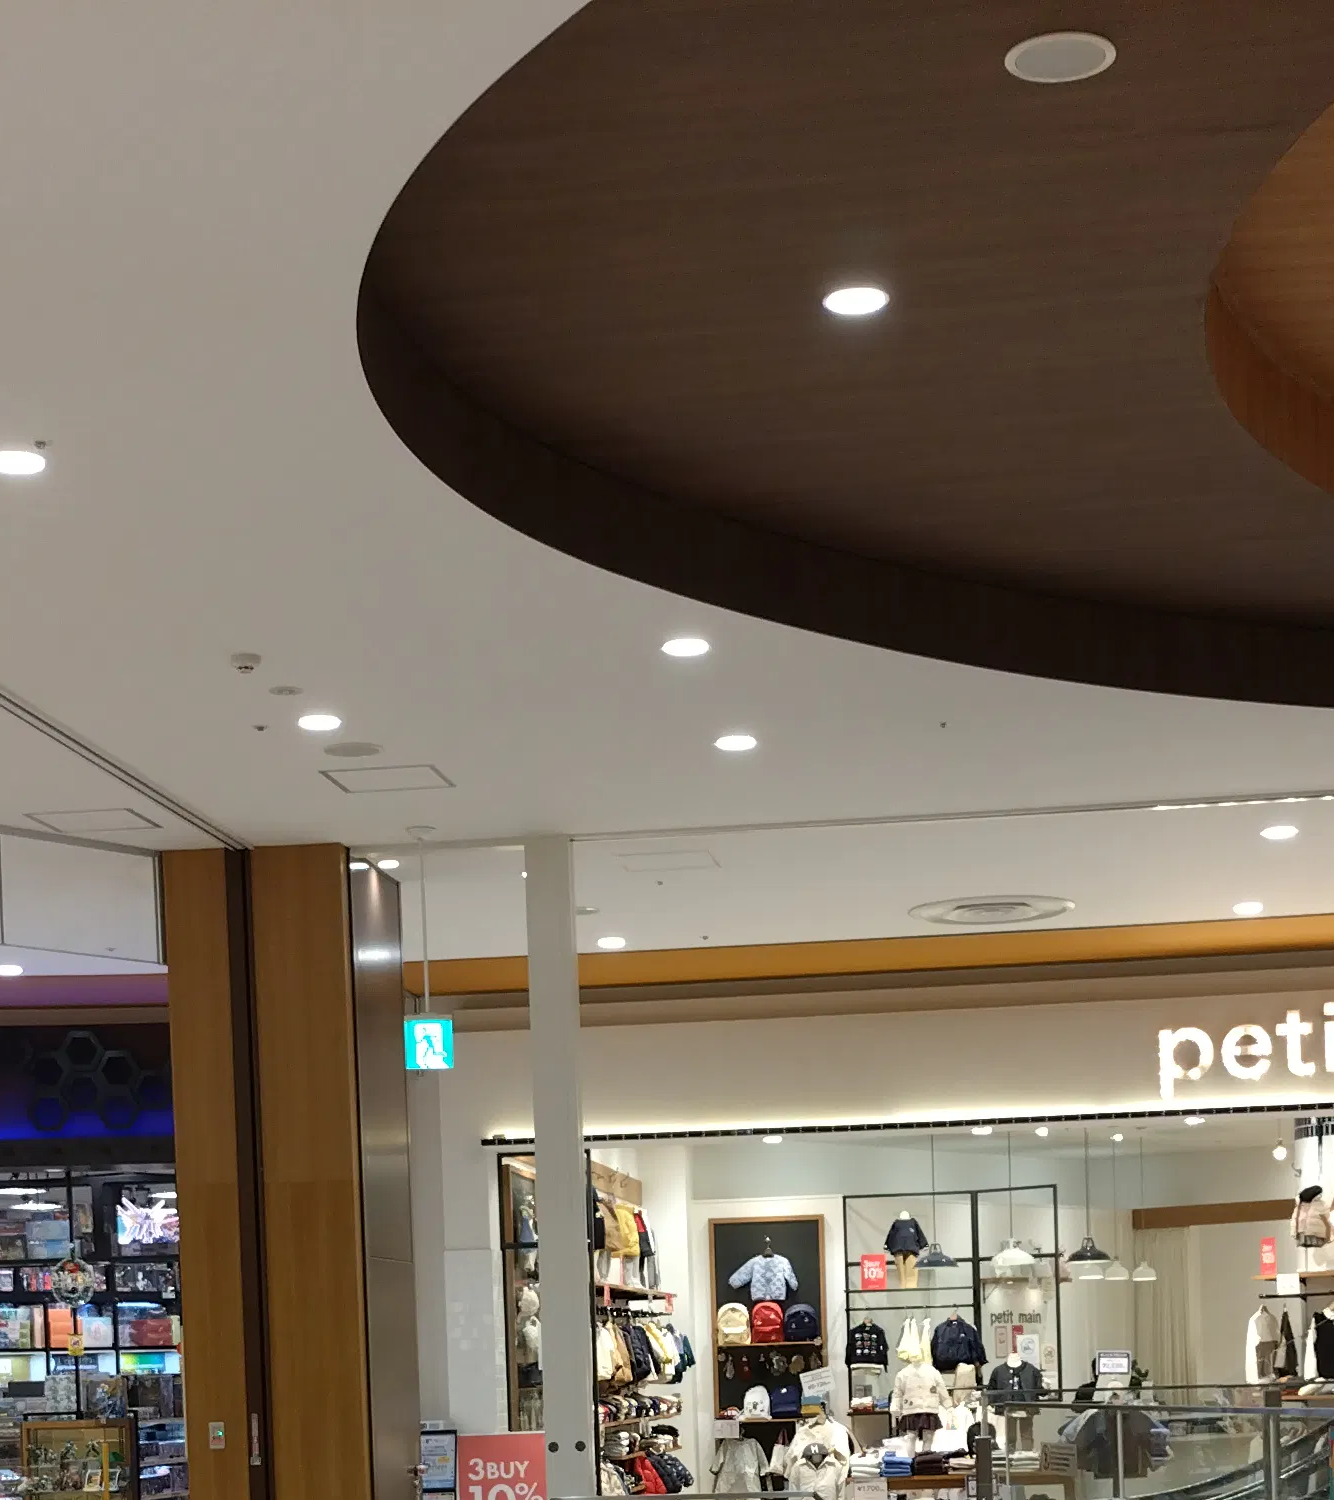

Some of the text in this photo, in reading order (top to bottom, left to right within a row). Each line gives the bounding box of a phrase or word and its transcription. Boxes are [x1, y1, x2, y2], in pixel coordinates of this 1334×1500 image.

[864, 1267, 884, 1280] 10%
[990, 1312, 1042, 1326] petit main
[468, 1457, 530, 1481] 3BUY
